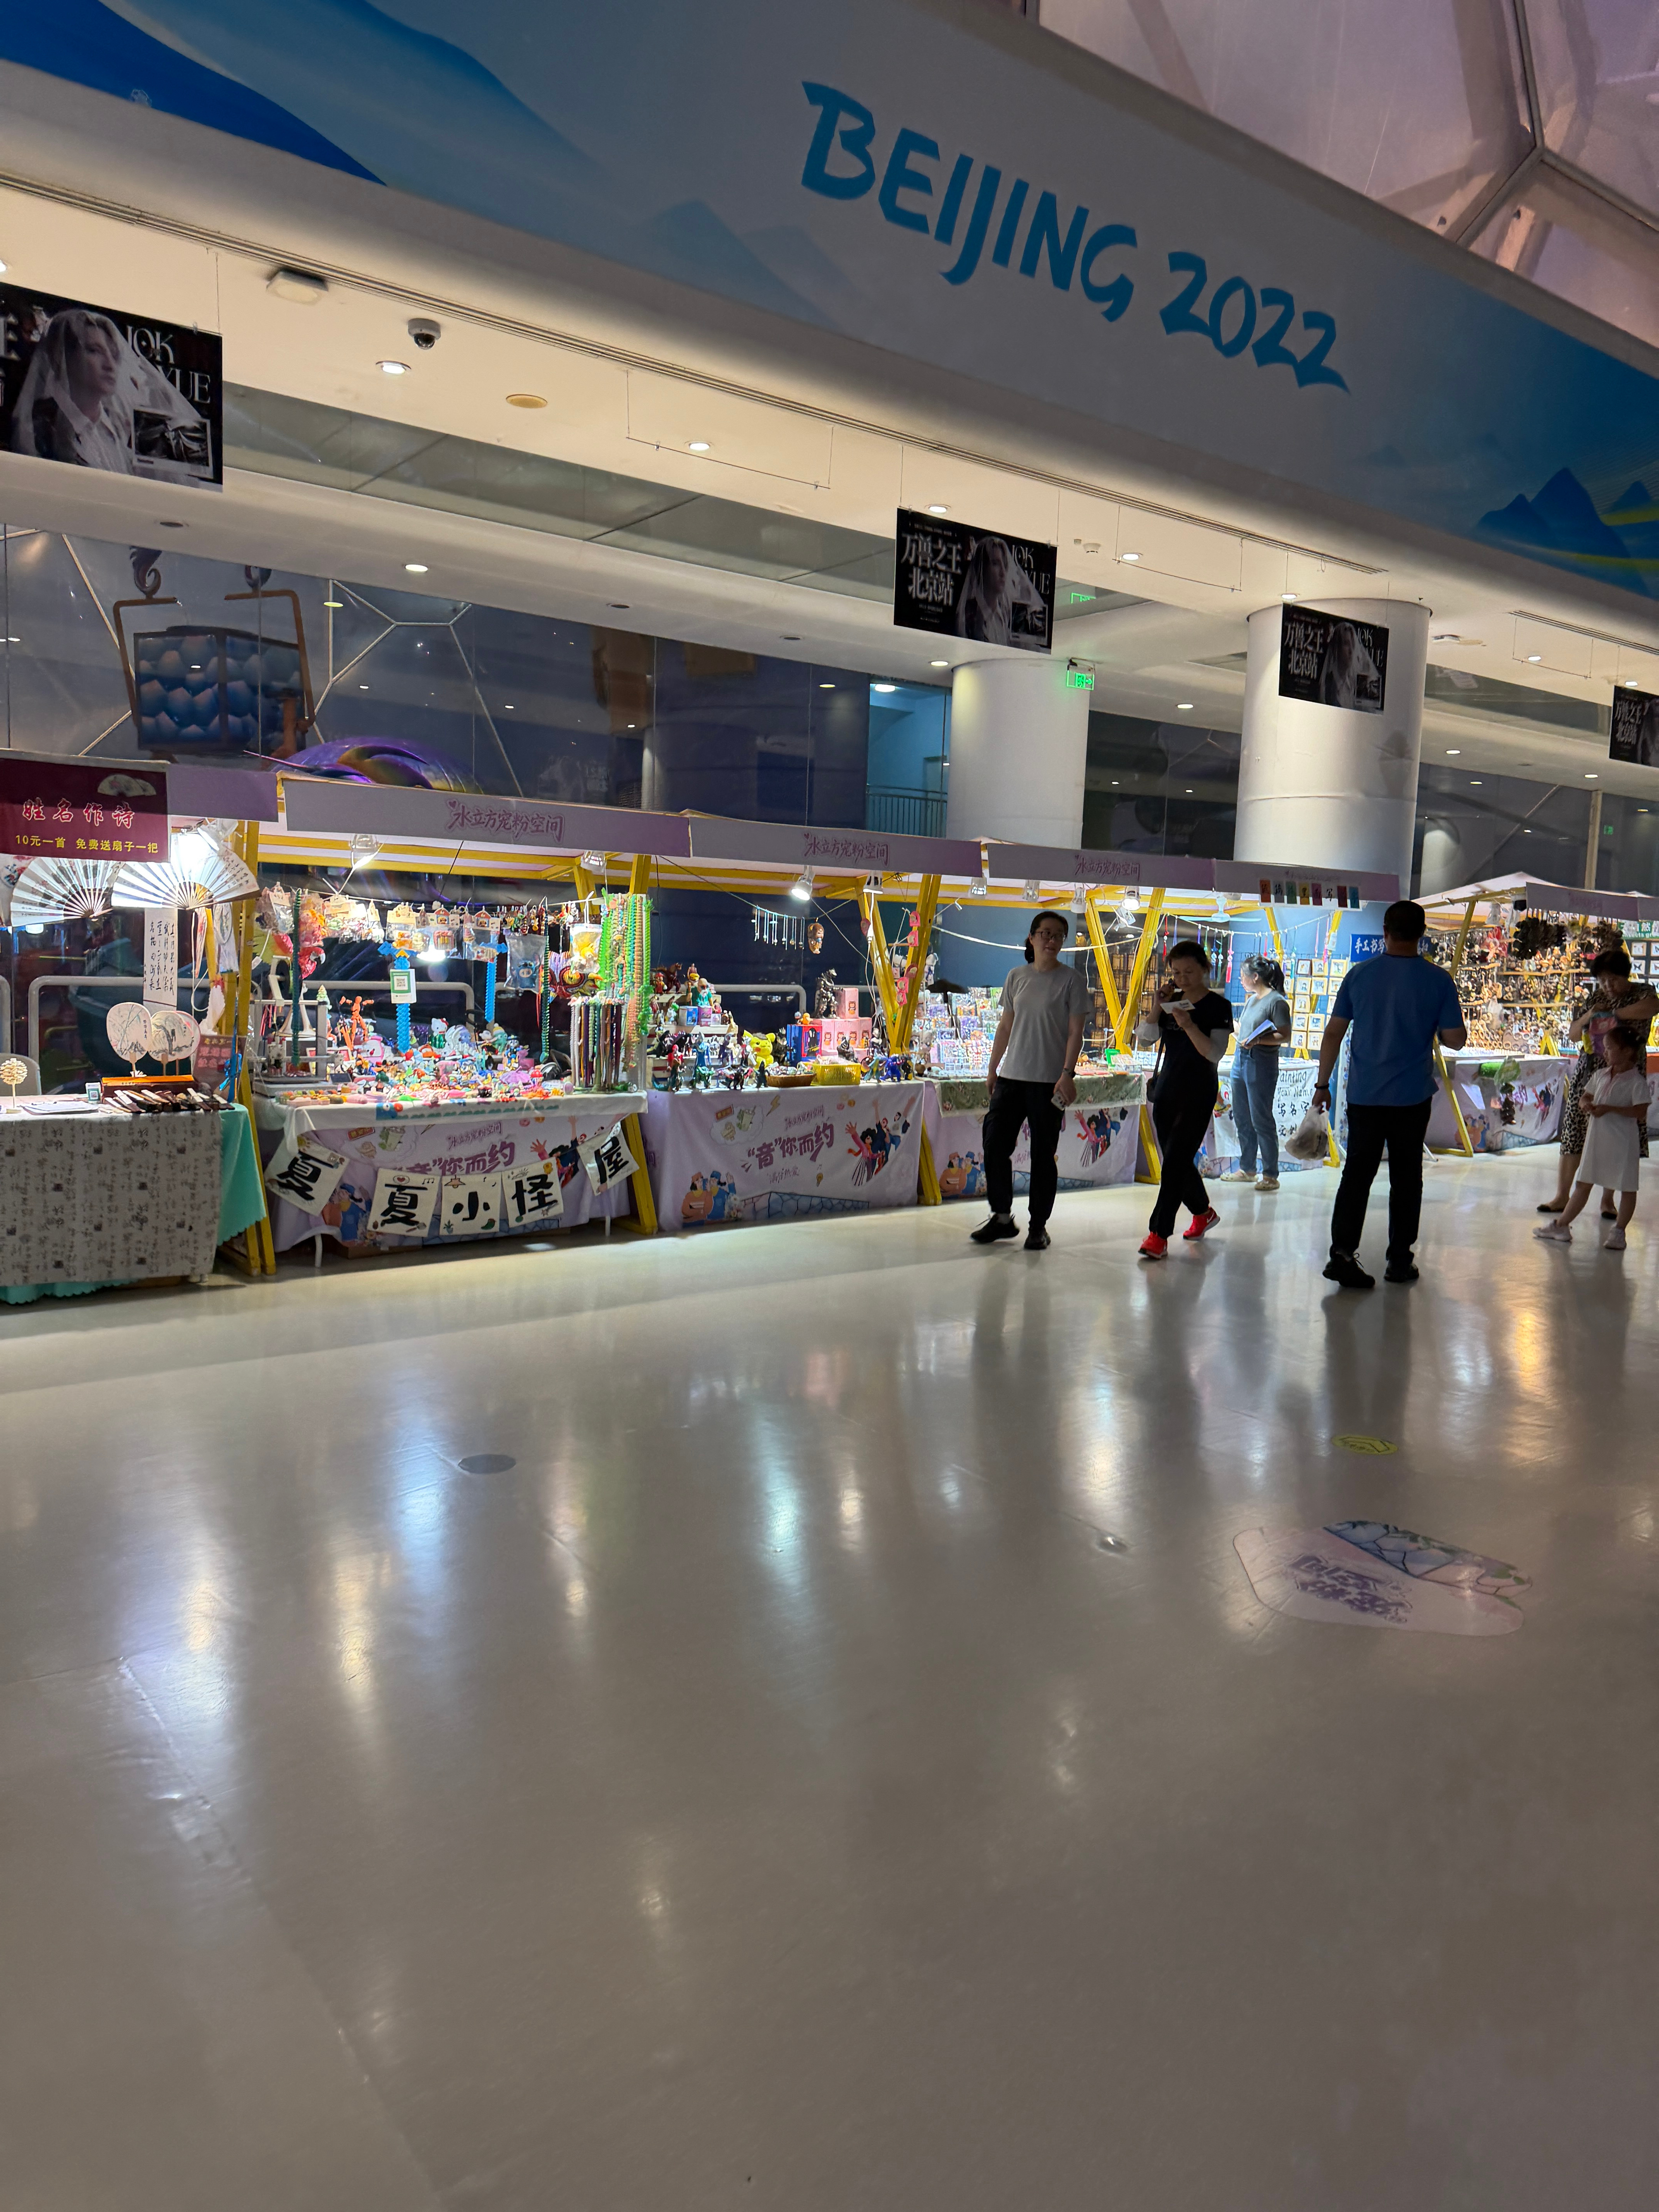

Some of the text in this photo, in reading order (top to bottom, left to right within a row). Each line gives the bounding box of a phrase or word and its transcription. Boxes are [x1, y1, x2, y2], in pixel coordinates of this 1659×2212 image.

[802, 81, 1350, 395] BEIJING 2022
[901, 532, 962, 575] 万兽之王
[908, 566, 954, 606] 北京站
[22, 797, 135, 829] 姓名作诗
[448, 805, 563, 842] 水立方宠粉空间
[15, 835, 158, 854] 10元一首 免费送扇子一把
[804, 836, 888, 866] 水立方宠粉空间
[1278, 1070, 1307, 1085] ainting
